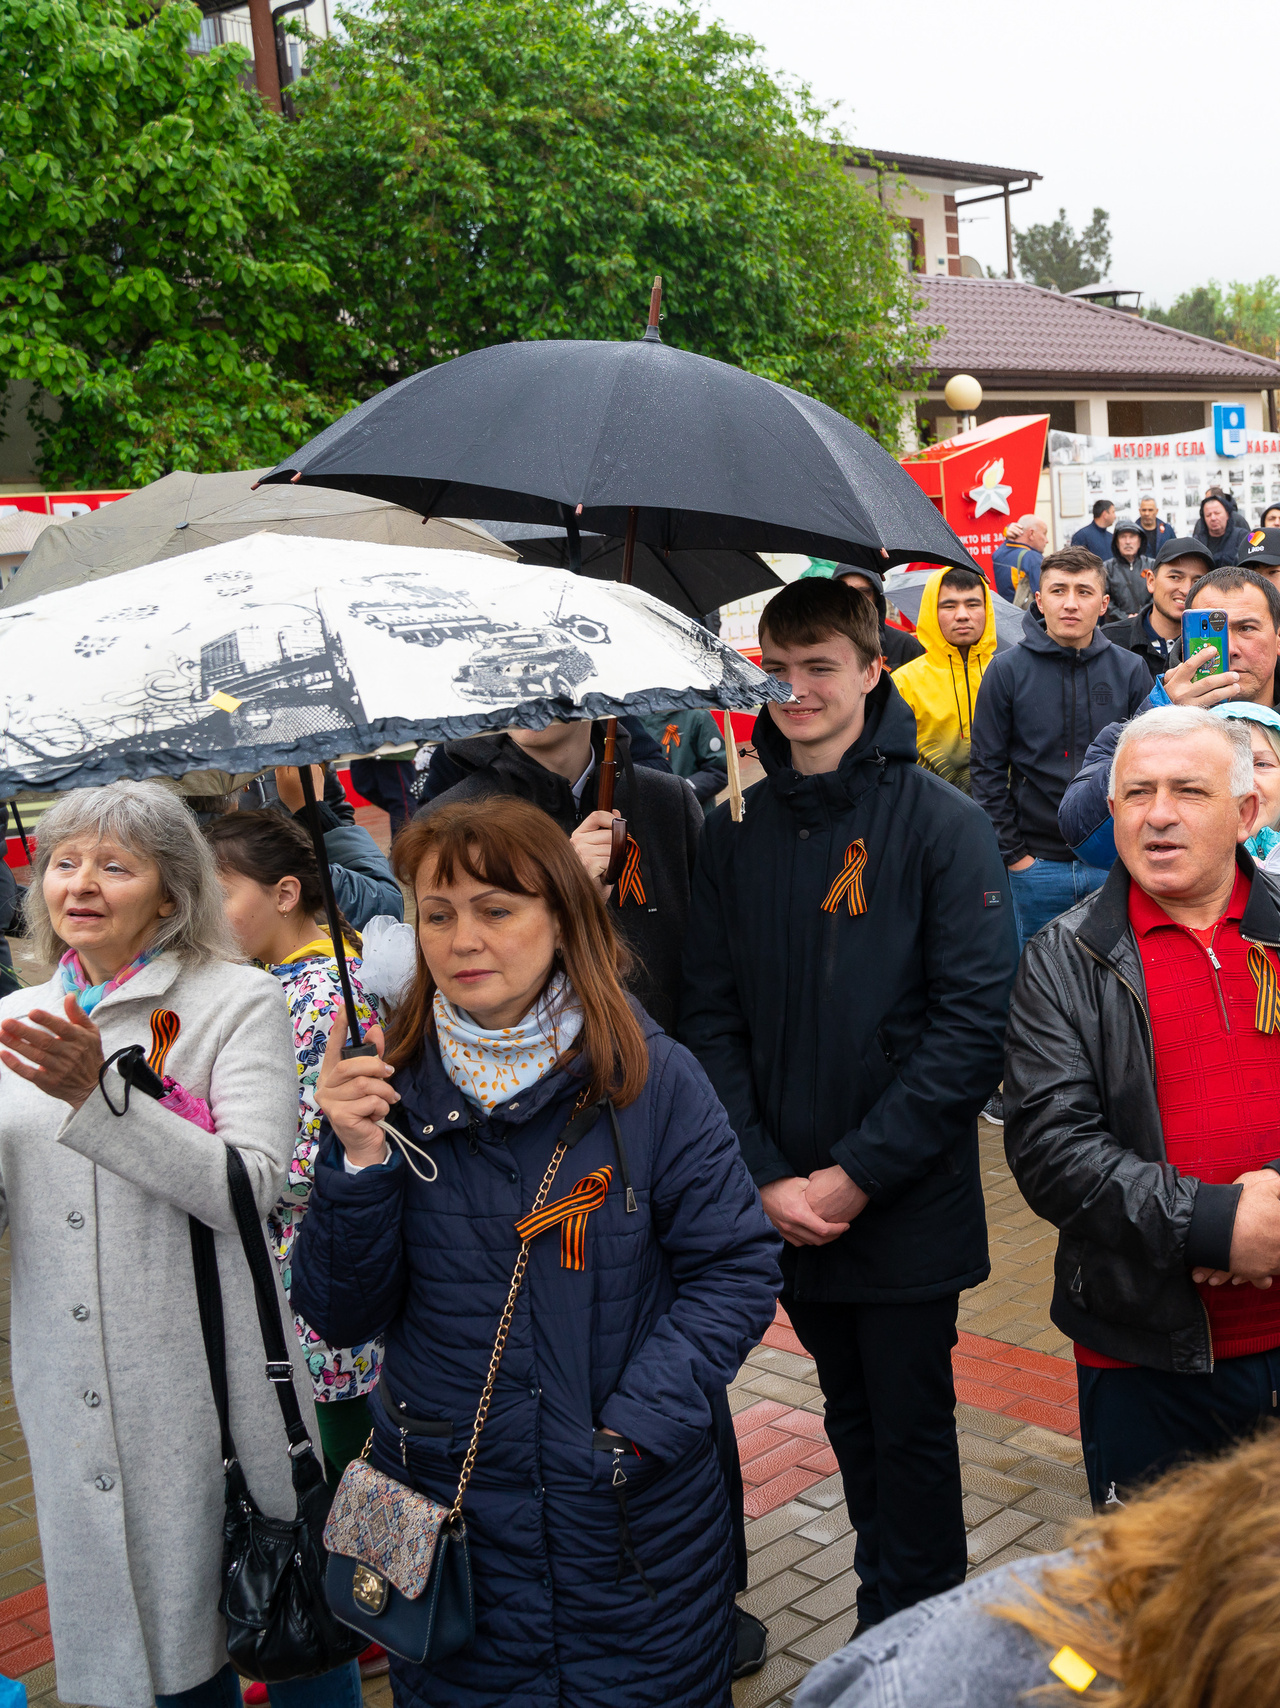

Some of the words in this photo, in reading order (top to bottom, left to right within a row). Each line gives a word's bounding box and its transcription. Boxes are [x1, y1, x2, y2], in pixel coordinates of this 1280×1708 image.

[1114, 442, 1169, 458] ИСТОРИЯ
[1176, 441, 1206, 457] СЕЛА
[959, 534, 979, 545] ИКТО
[981, 533, 992, 543] НЕ
[981, 545, 992, 555] НЕ
